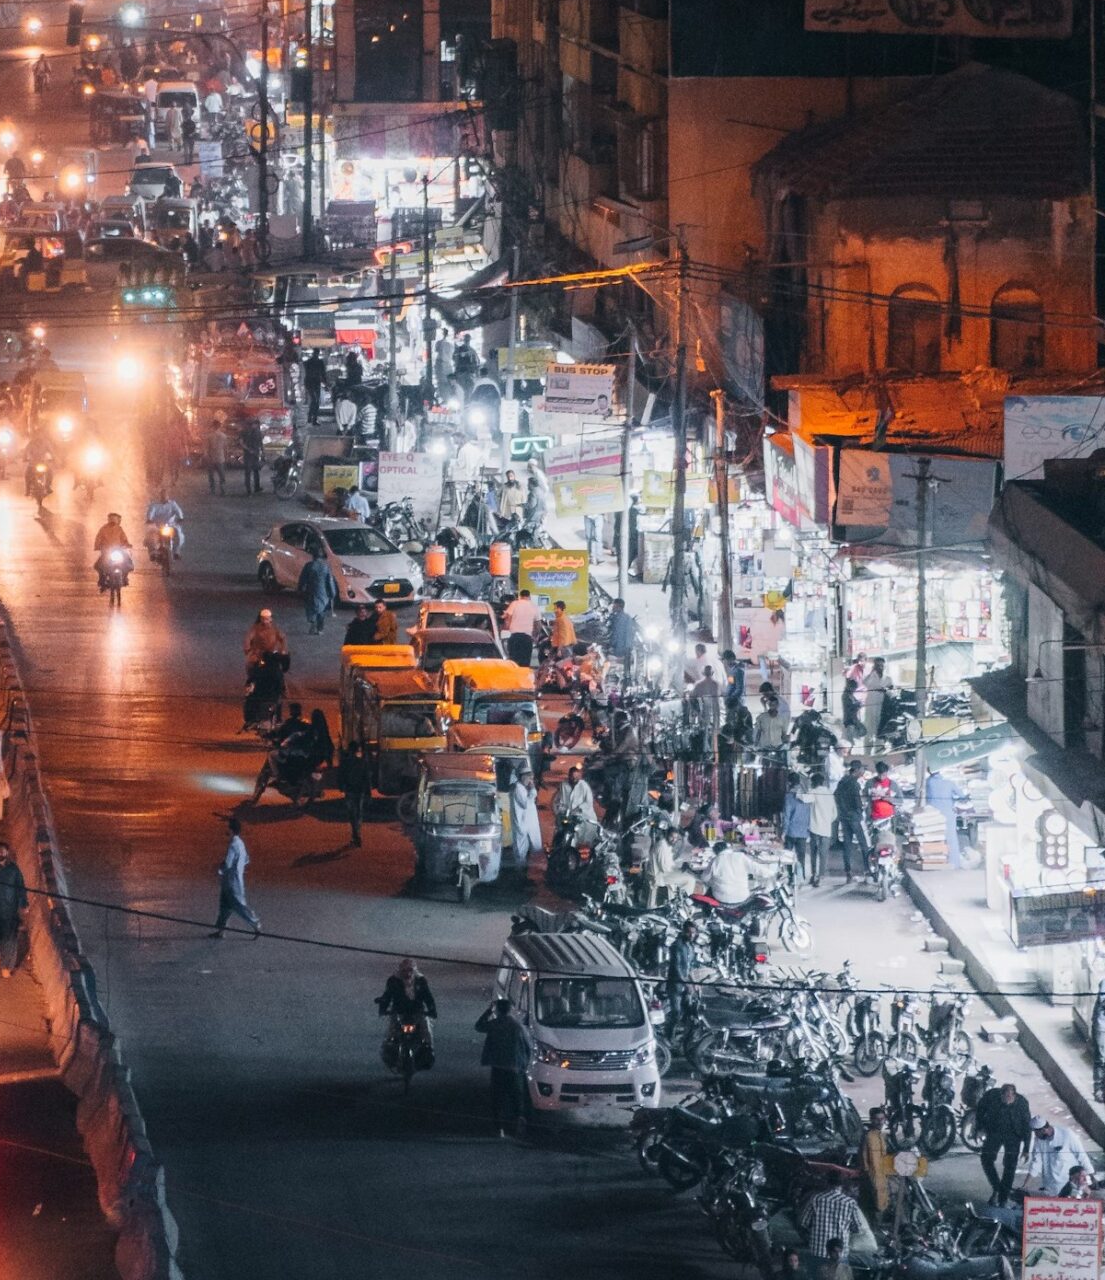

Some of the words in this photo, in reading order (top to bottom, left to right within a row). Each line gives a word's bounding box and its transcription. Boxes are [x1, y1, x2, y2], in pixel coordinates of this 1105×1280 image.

[554, 366, 576, 374] BUS
[579, 367, 608, 376] STOP
[379, 466, 418, 475] OPTICAL
